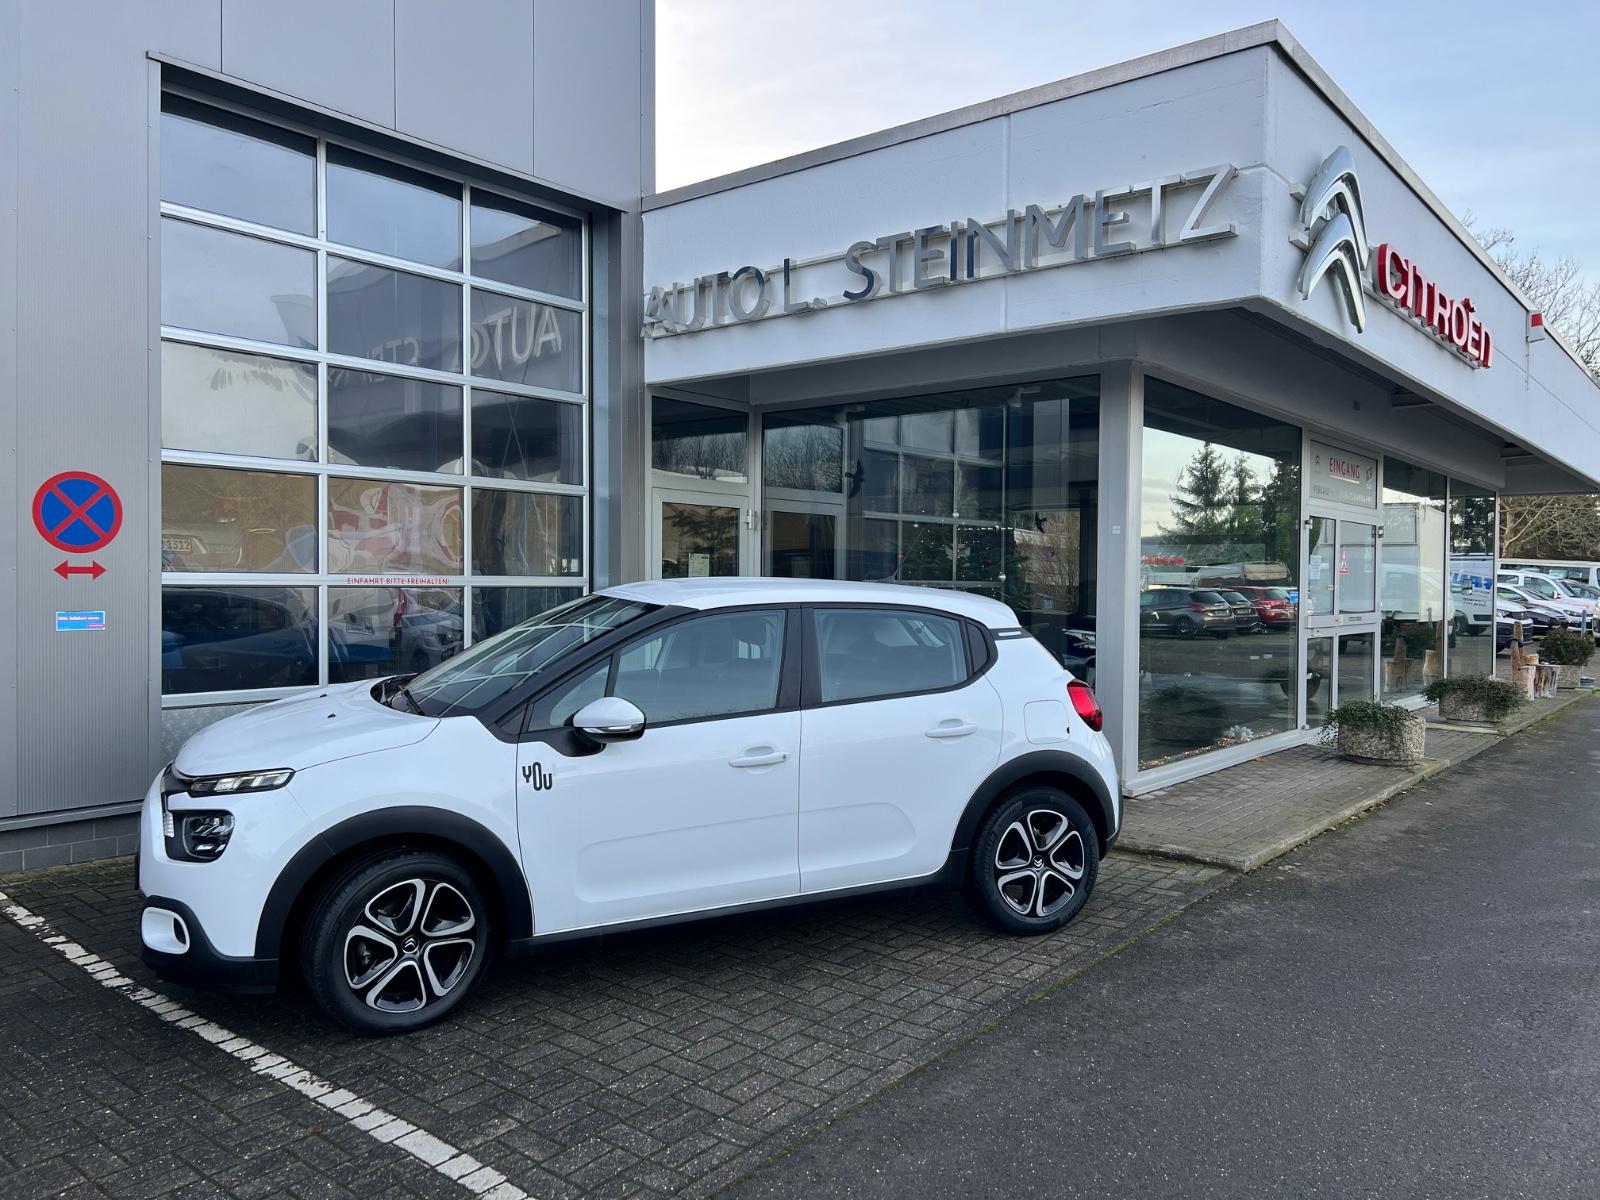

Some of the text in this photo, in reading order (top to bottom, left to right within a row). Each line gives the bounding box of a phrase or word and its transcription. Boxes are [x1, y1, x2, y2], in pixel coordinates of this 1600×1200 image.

[644, 265, 771, 333] AUTO
[843, 163, 1239, 301] STEINMETZ
[1329, 457, 1361, 480] EINGANG
[347, 577, 383, 585] EINFAHRT
[386, 577, 405, 585] BITTE
